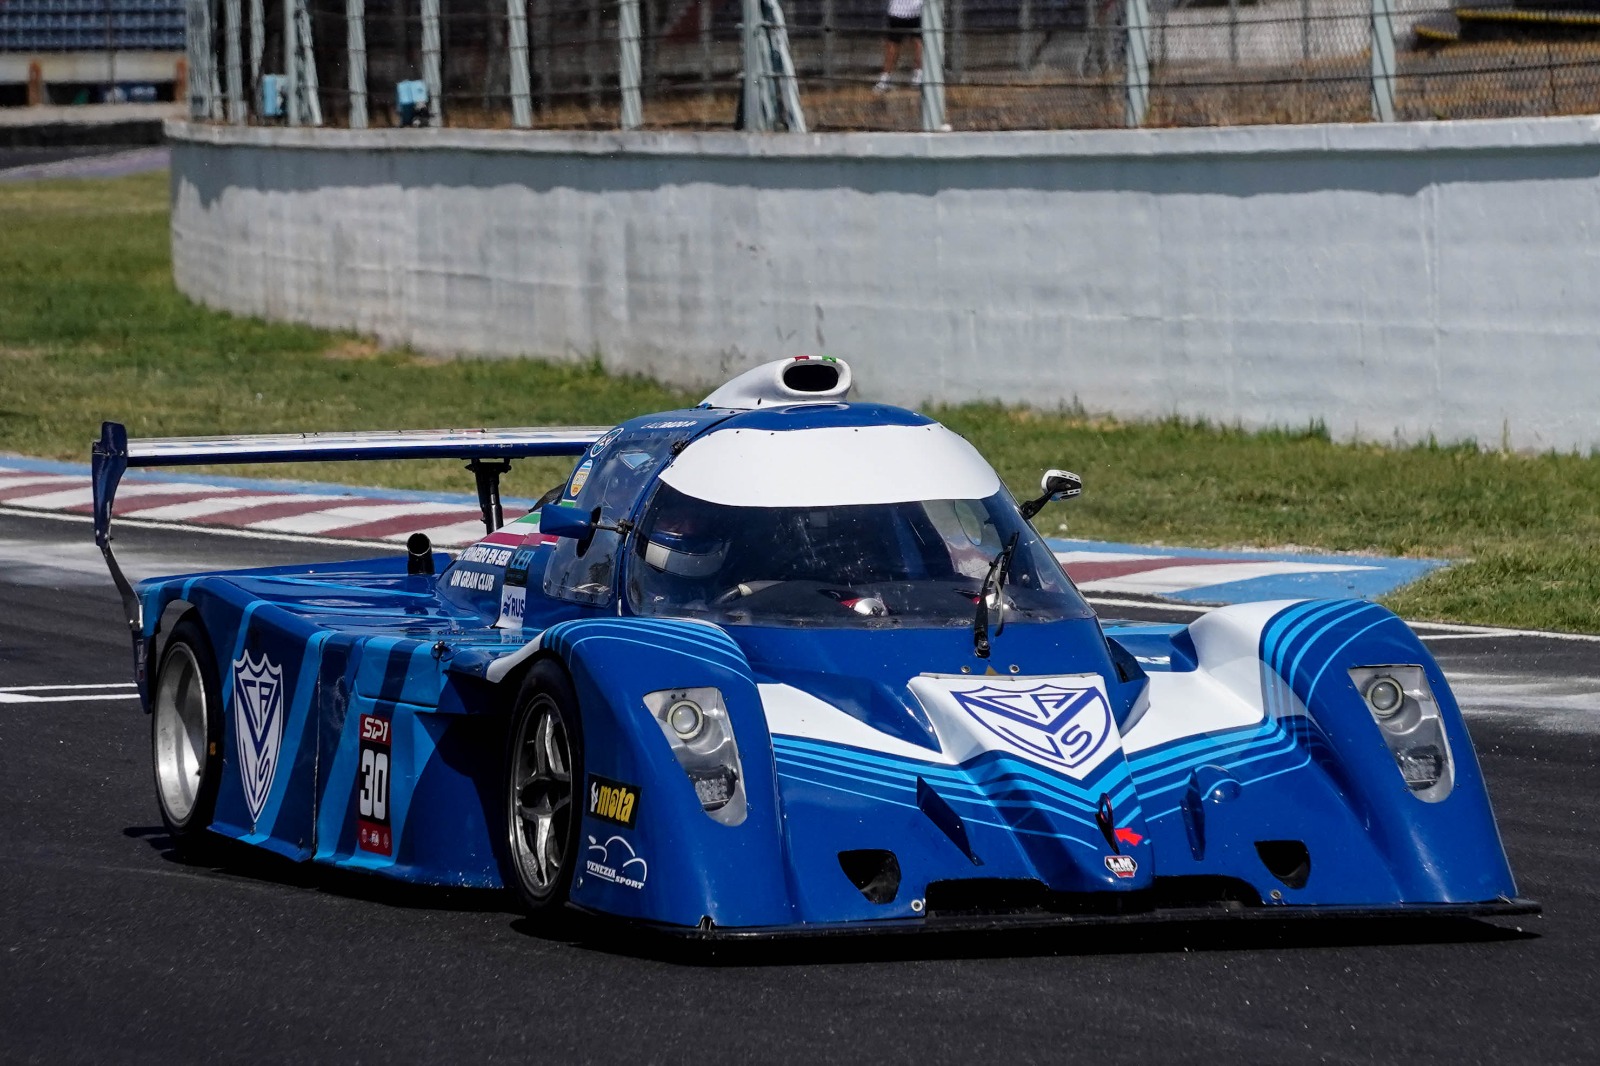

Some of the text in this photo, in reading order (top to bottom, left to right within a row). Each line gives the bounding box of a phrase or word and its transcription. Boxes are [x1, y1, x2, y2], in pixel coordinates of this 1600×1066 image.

[485, 548, 501, 565] EN
[494, 550, 512, 567] SER
[450, 570, 461, 587] UN
[460, 571, 480, 589] GRAN
[478, 573, 495, 591] CLUB
[360, 748, 389, 821] 30
[597, 785, 635, 824] mota
[586, 860, 616, 878] VENEZIA
[615, 875, 645, 890] SPORT
